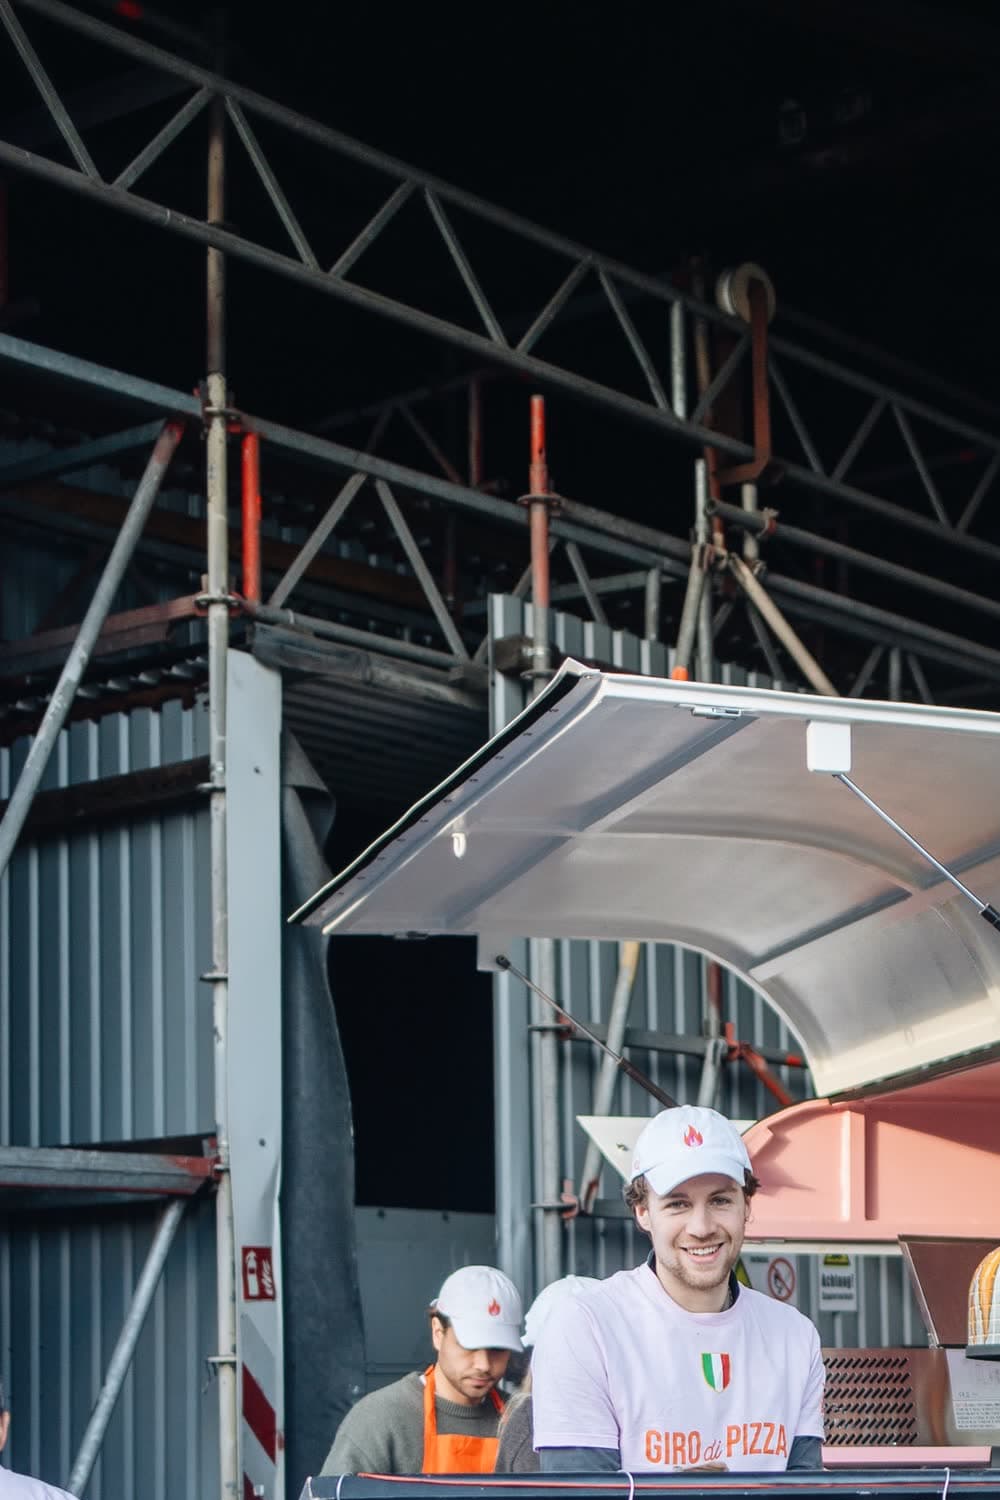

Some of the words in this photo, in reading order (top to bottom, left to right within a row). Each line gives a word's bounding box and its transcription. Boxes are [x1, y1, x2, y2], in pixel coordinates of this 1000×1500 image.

[645, 1429, 701, 1465] GIRO
[703, 1439, 722, 1462] di
[726, 1422, 788, 1459] PIZZA
